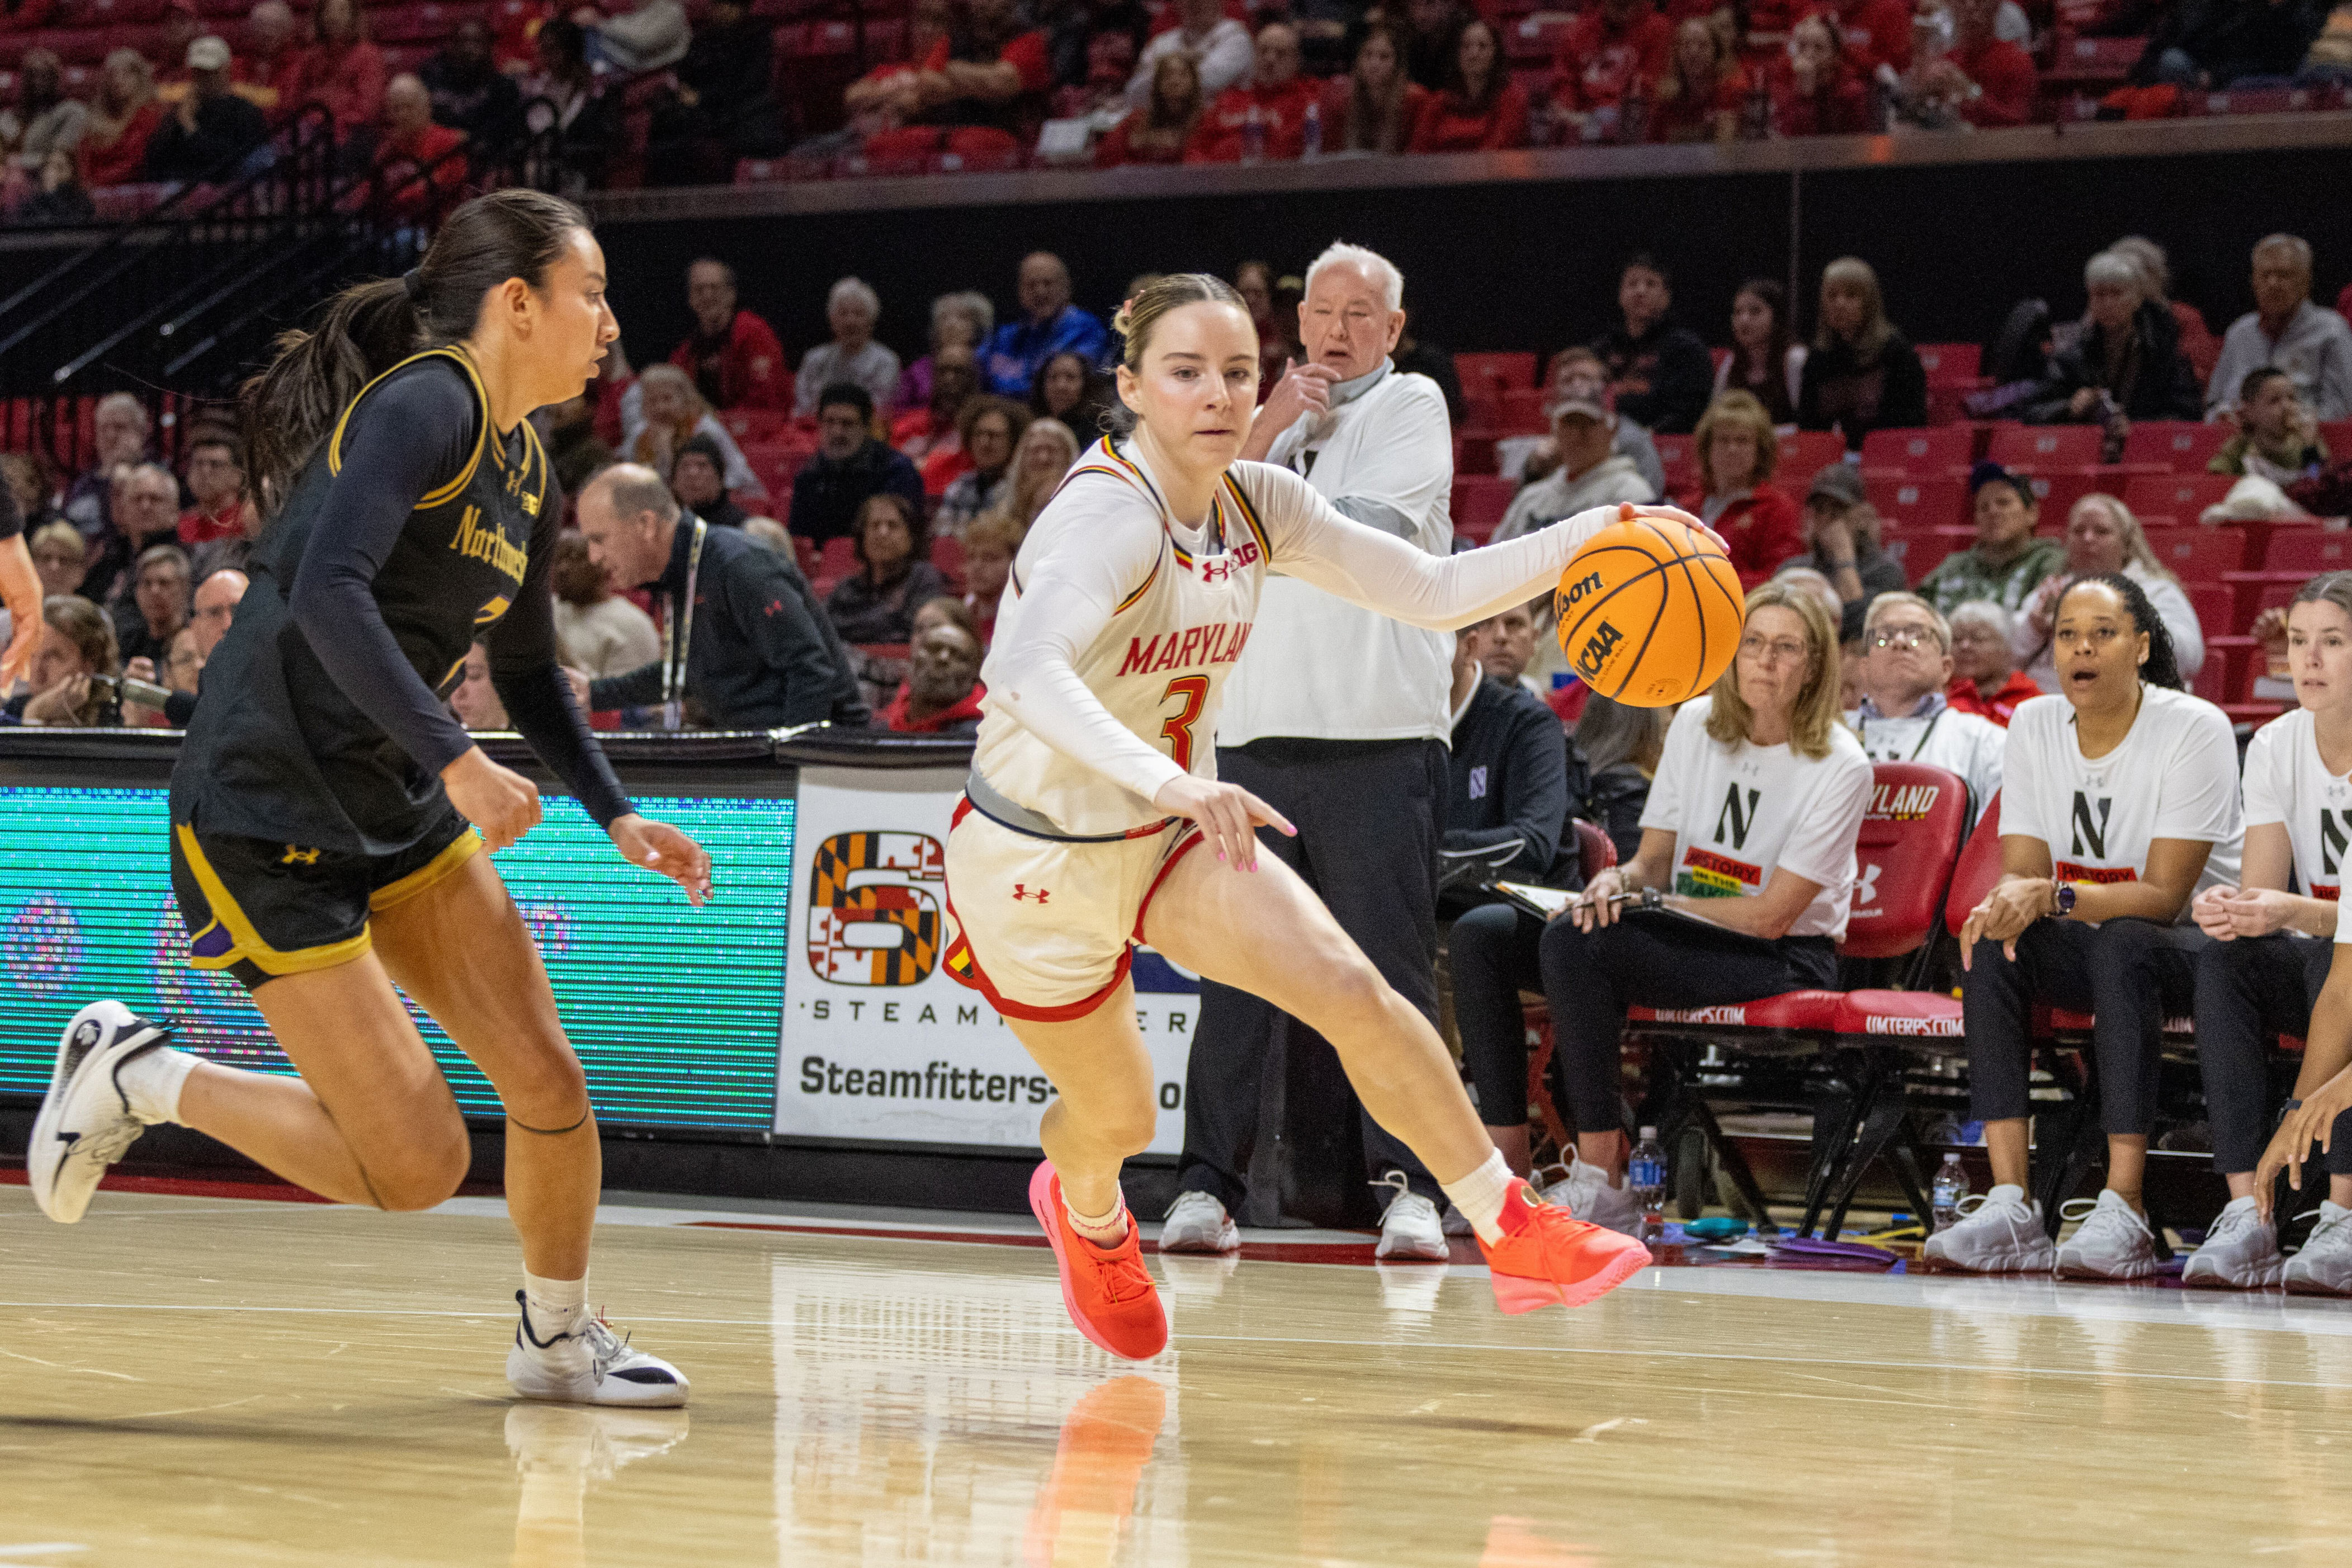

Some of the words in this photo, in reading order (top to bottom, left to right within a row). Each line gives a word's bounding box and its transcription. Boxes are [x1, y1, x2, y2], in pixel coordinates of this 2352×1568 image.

[1116, 621, 1253, 677] MARYLAN
[1574, 620, 1624, 686] NCAA
[1158, 674, 1210, 774] 3
[1468, 765, 1487, 800] N
[1867, 784, 1939, 814] YLAND
[1713, 781, 1761, 851] N
[2072, 791, 2112, 859] N
